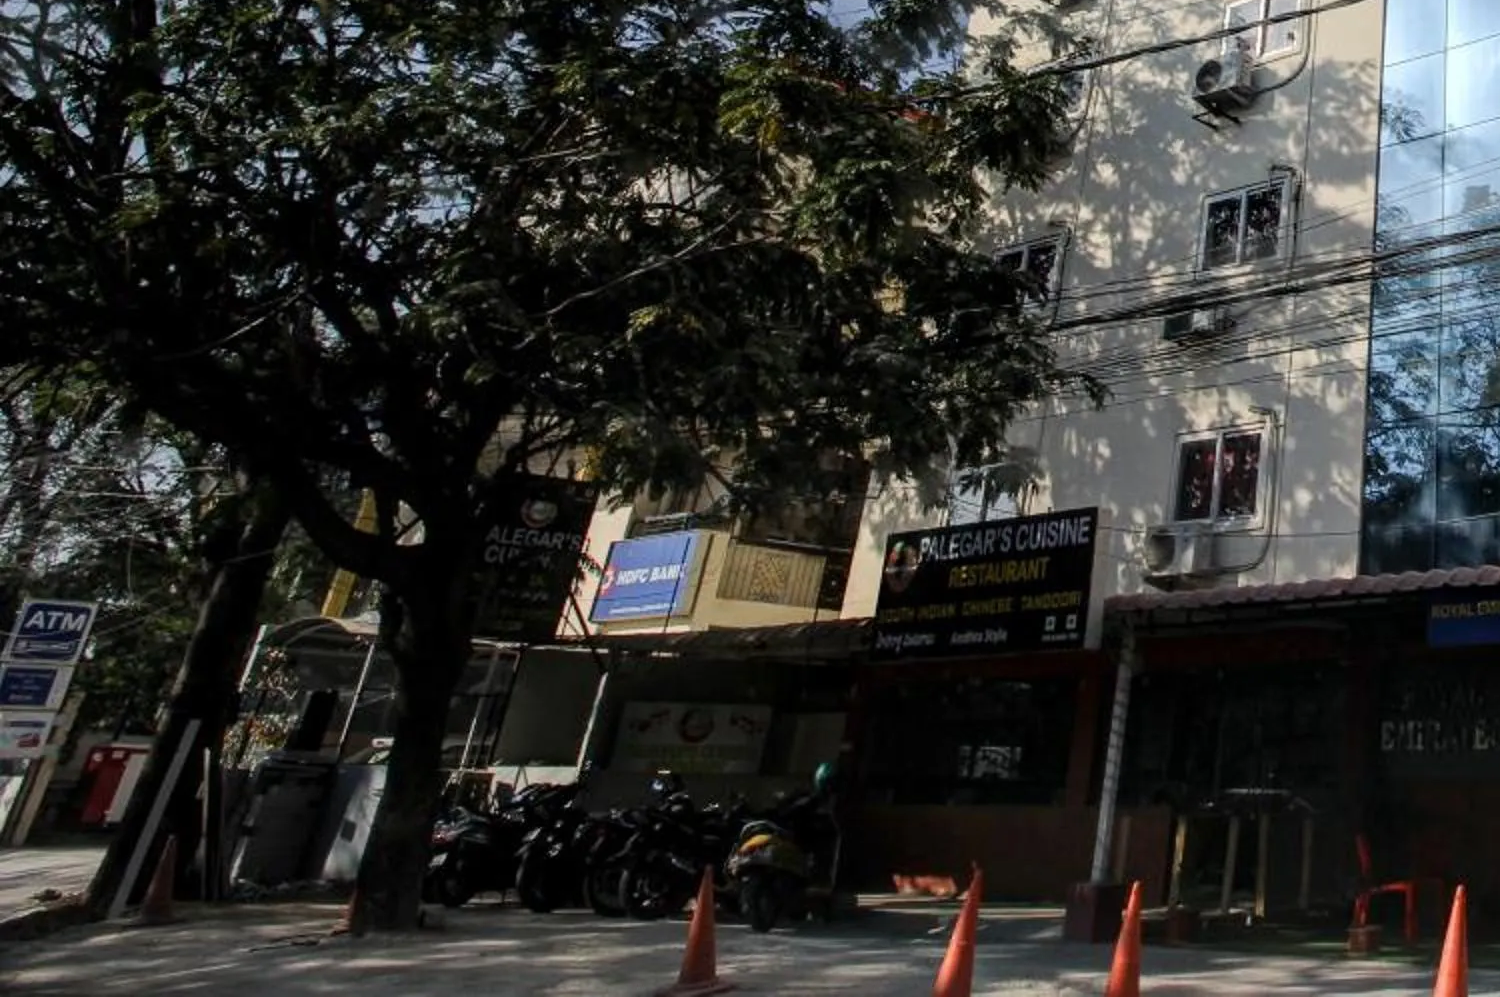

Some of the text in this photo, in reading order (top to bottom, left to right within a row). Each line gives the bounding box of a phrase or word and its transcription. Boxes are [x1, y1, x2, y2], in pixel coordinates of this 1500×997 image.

[918, 516, 1092, 563] PALEGAR'S CUISINE
[616, 567, 650, 586] HDFC
[948, 557, 1050, 588] RESTAURANT
[25, 609, 86, 632] ATM
